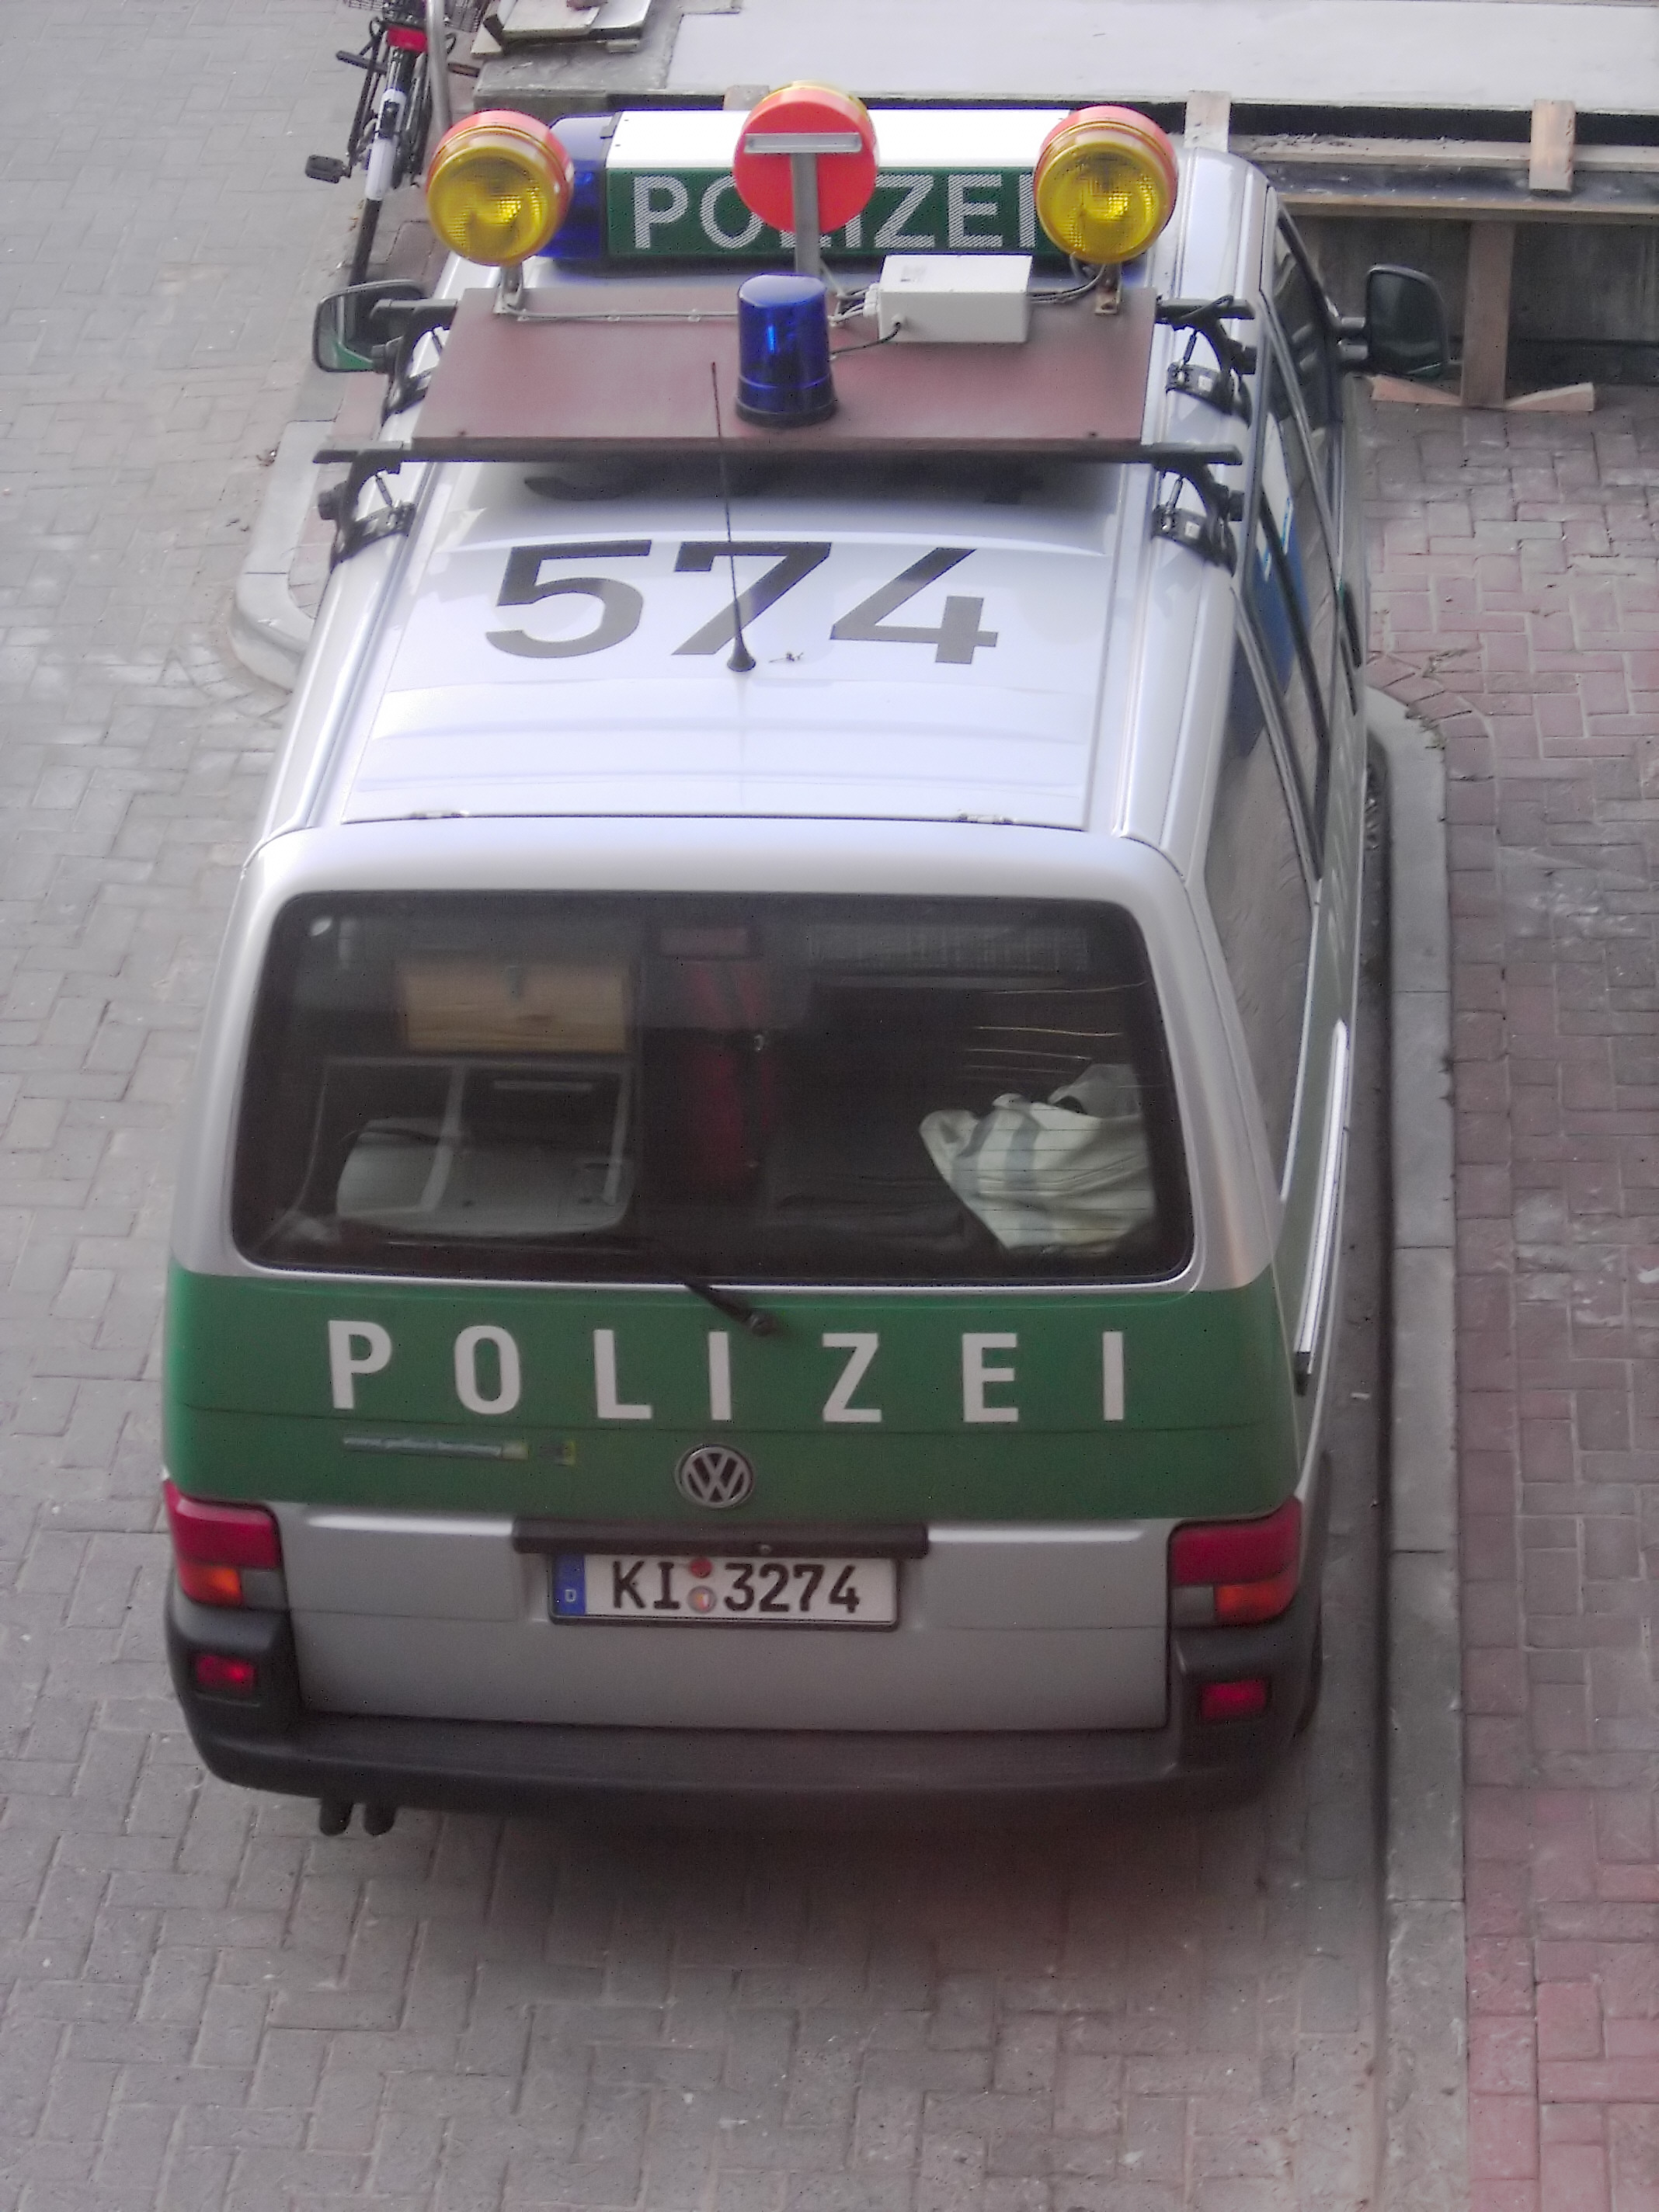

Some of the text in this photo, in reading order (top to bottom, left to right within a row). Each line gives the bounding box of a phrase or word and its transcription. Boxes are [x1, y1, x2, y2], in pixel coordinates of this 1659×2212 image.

[486, 539, 999, 665] 574
[328, 1319, 1125, 1423] POLIZEI
[677, 1445, 753, 1508] VW
[565, 1560, 860, 1613] D KI 3274
